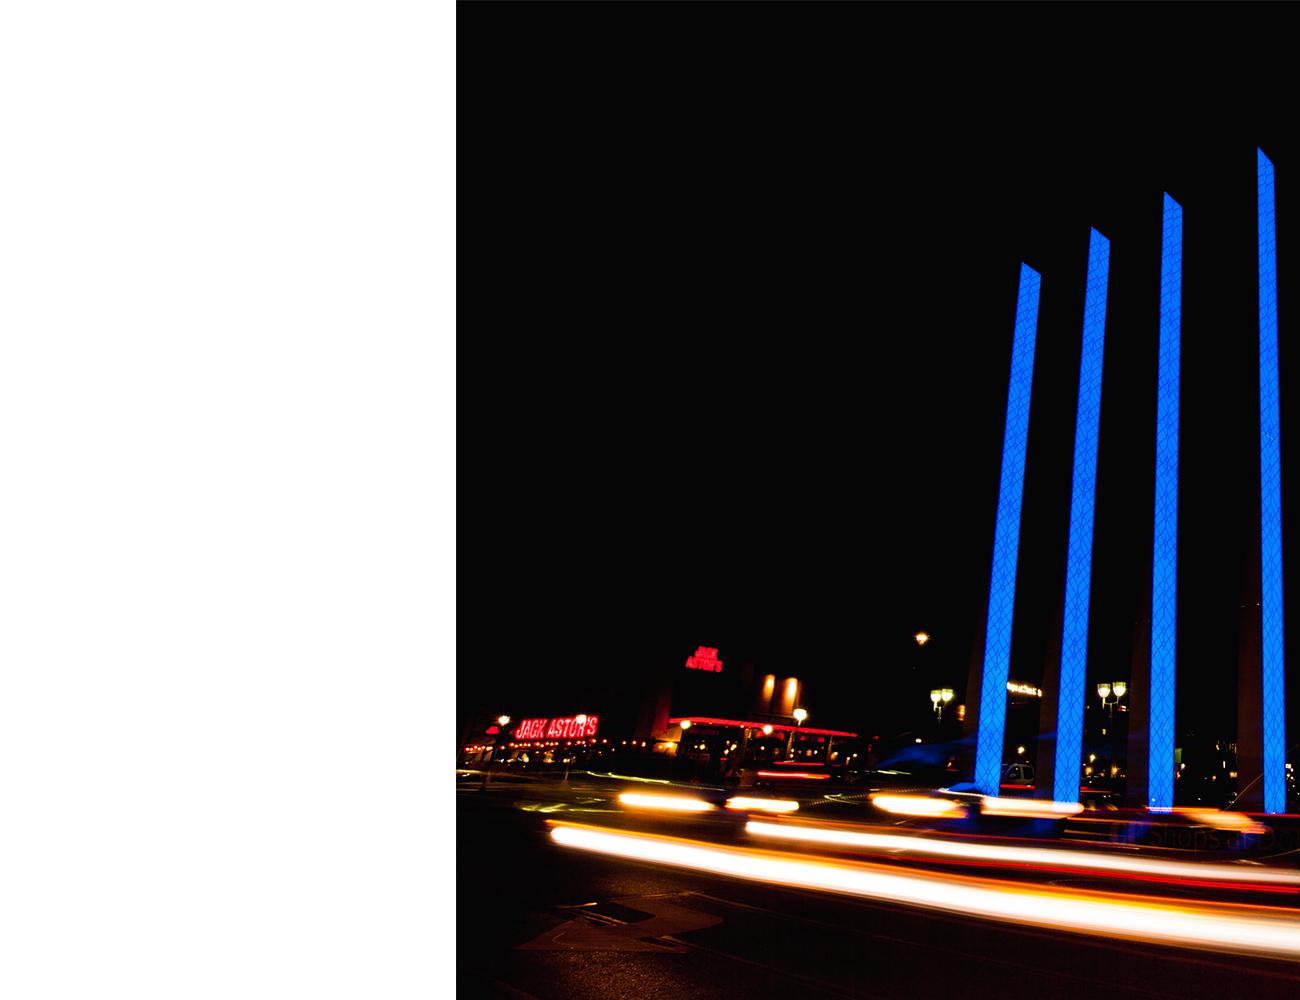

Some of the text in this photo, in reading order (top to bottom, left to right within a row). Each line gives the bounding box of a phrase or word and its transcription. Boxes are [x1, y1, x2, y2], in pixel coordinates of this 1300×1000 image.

[695, 646, 718, 659] JACK
[685, 656, 723, 673] ASTOR'S
[515, 716, 598, 739] JACK ASTOR'S
[1148, 822, 1220, 854] Shops
